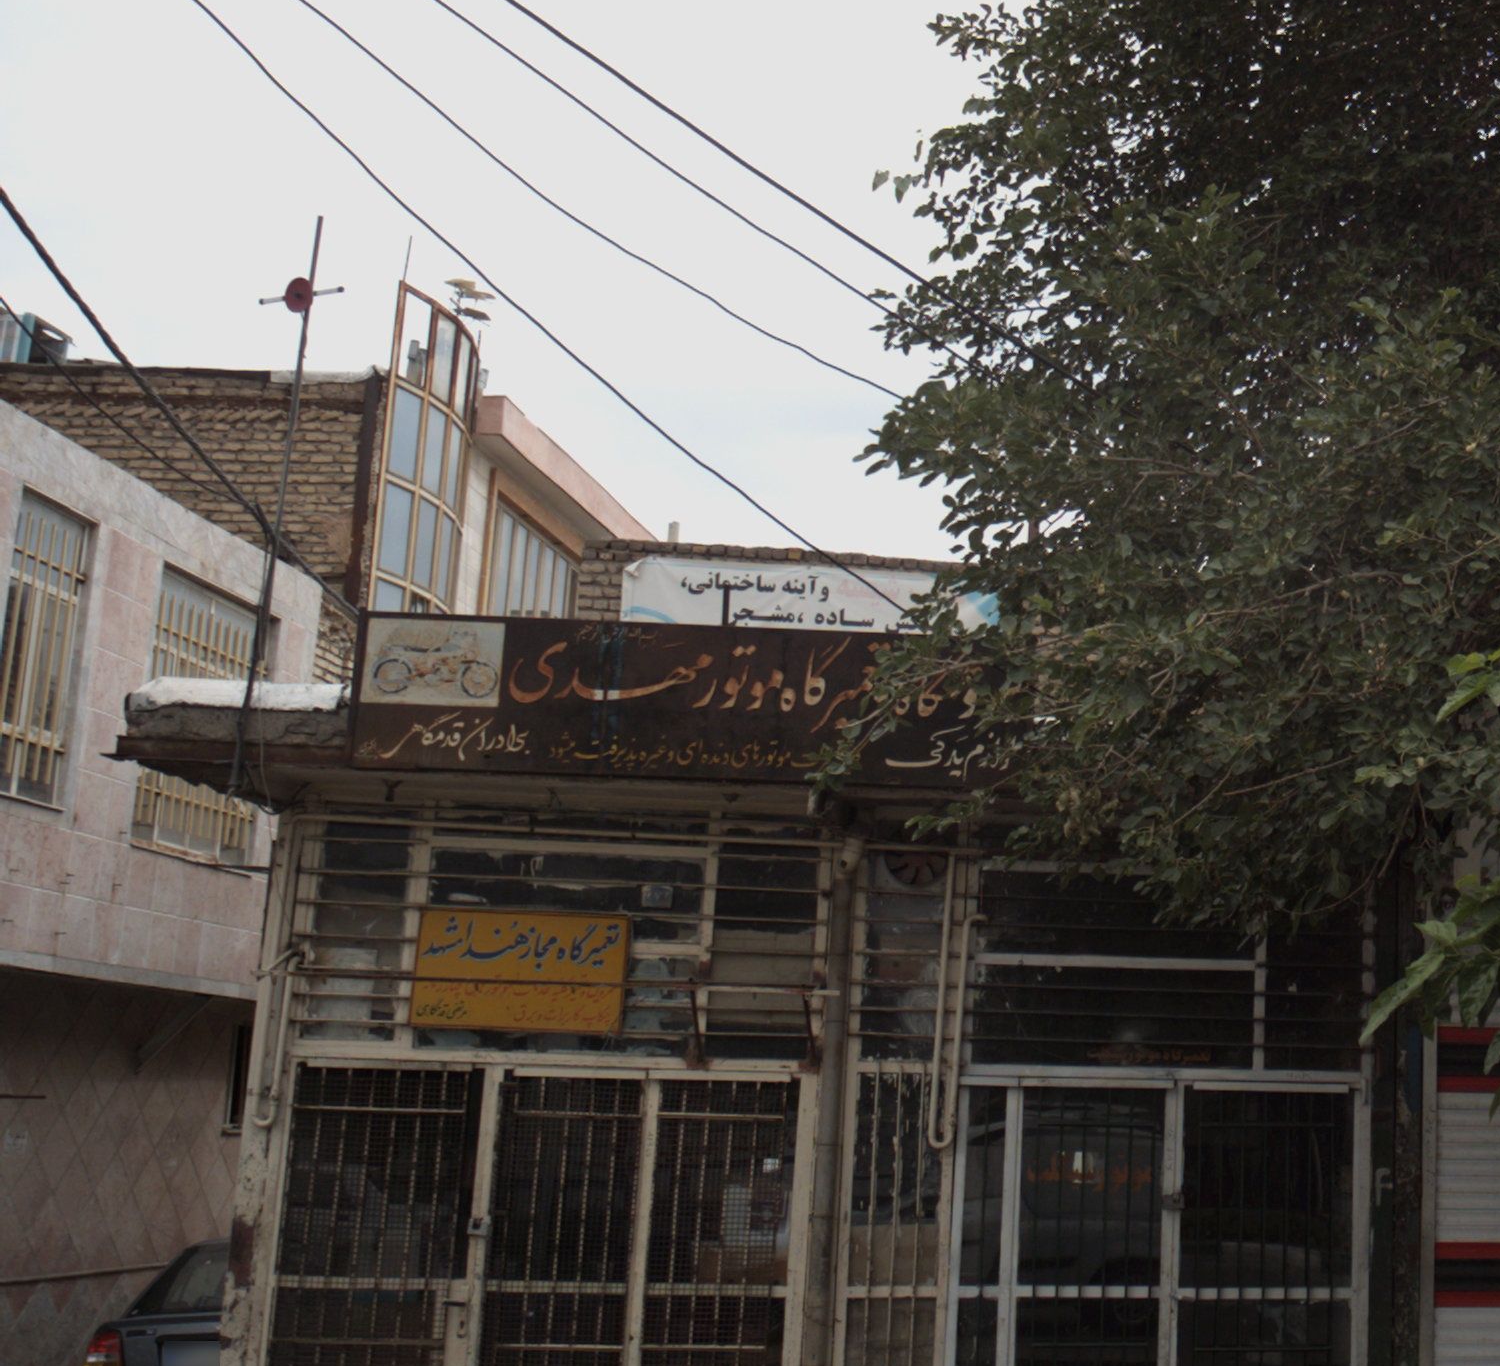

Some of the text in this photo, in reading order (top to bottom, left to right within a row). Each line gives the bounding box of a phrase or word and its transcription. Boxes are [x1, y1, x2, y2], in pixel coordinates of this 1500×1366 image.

[814, 608, 874, 628] ساده
[508, 640, 715, 705] مهدی
[692, 644, 784, 711] موتور
[517, 926, 558, 971] مجاز
[557, 923, 621, 967] تعمیرگاه
